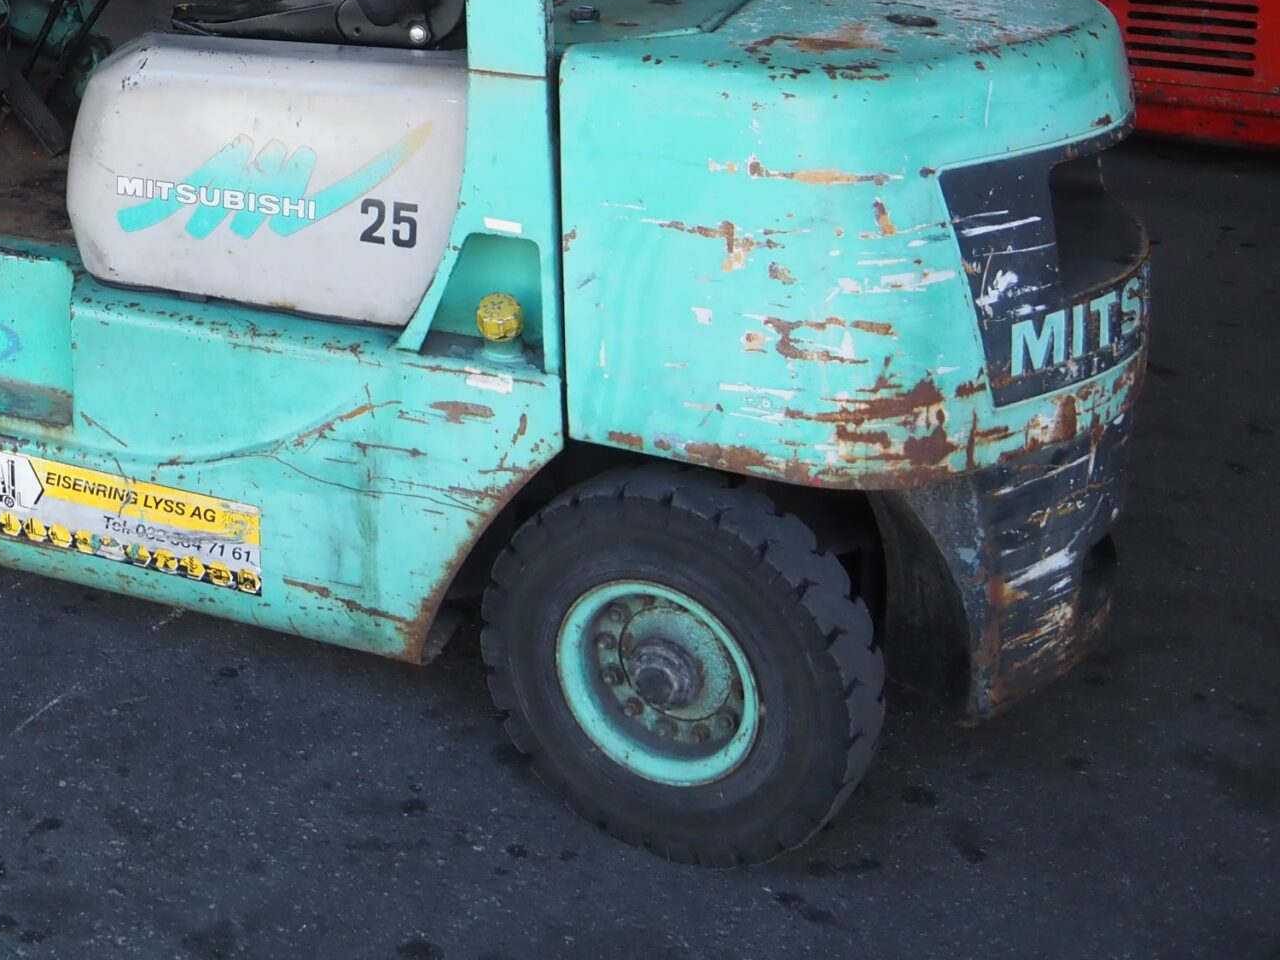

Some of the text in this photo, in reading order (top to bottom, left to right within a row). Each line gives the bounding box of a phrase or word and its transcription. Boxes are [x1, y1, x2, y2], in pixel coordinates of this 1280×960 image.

[116, 176, 317, 222] MITSUBISHI
[359, 197, 419, 249] 25
[1010, 276, 1142, 377] MITS
[45, 471, 139, 505] EISENRING
[143, 493, 186, 516] LYSS
[190, 506, 217, 523] AG
[208, 542, 226, 557] 71
[231, 546, 252, 563] 61
